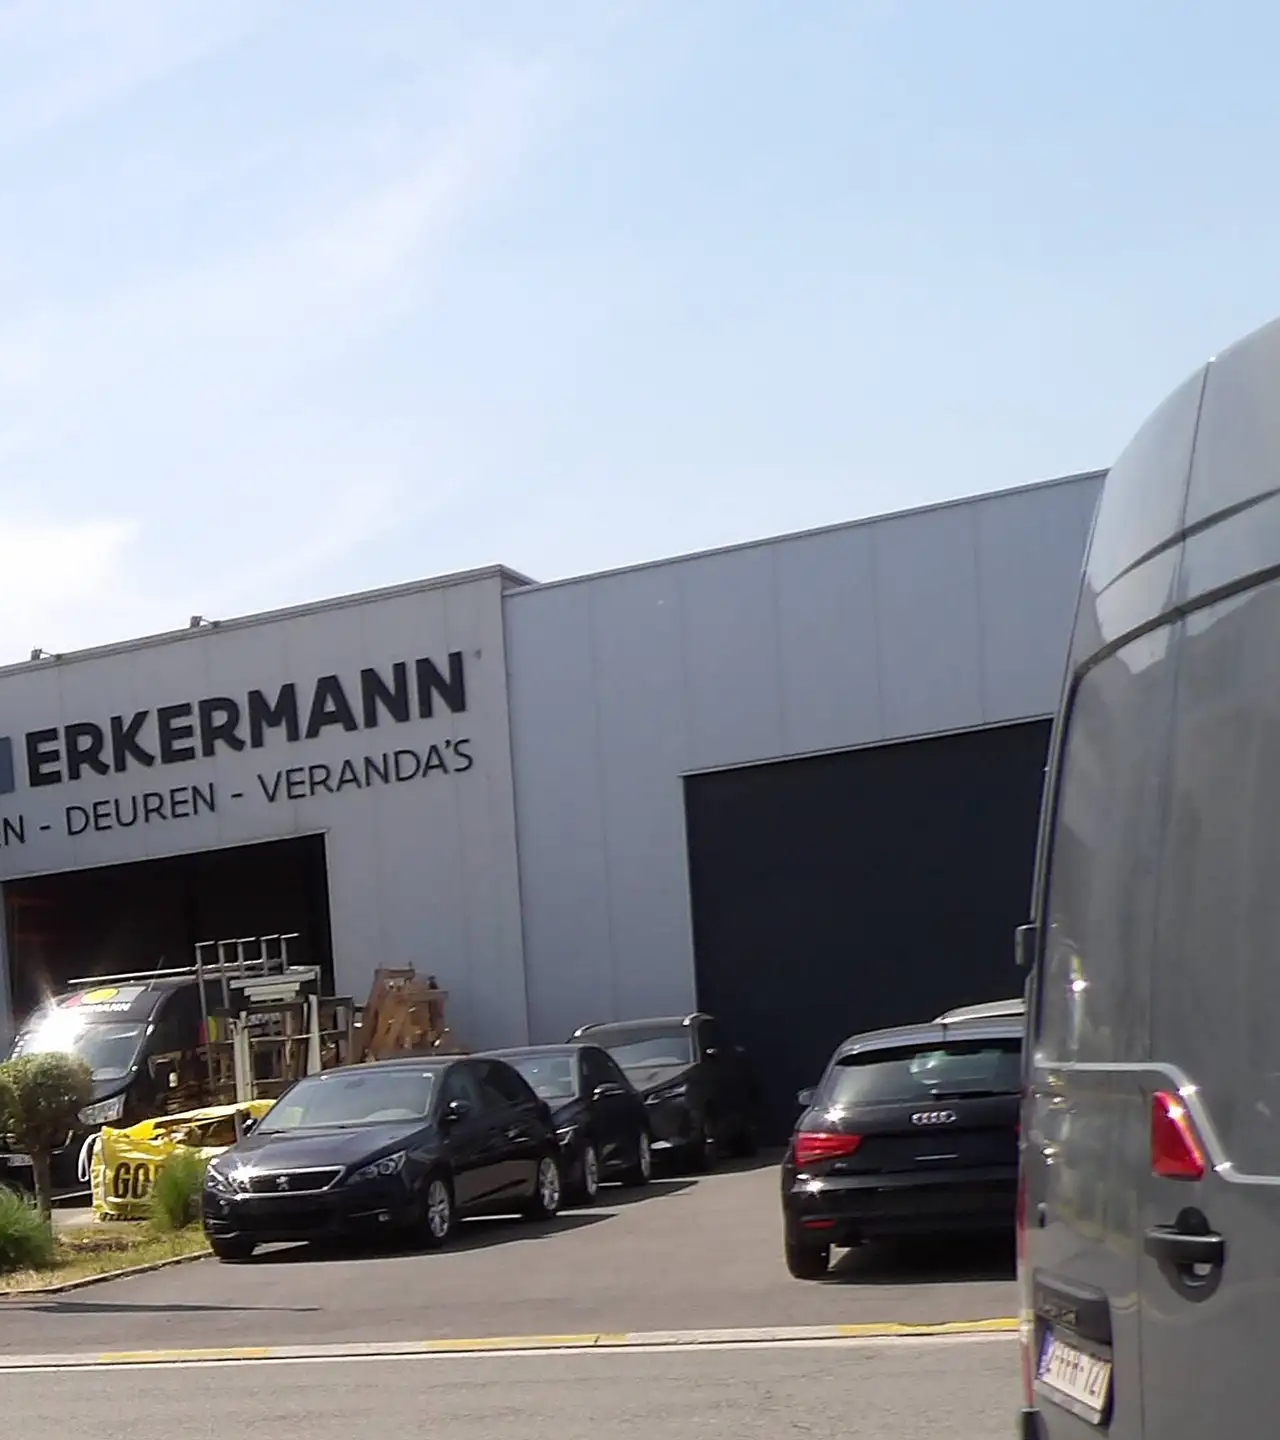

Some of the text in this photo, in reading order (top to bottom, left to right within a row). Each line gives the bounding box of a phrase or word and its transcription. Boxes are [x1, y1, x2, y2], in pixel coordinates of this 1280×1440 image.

[25, 651, 467, 788] ERKERMANN
[65, 783, 217, 836] DEUREN
[257, 738, 474, 804] VERANDA'S
